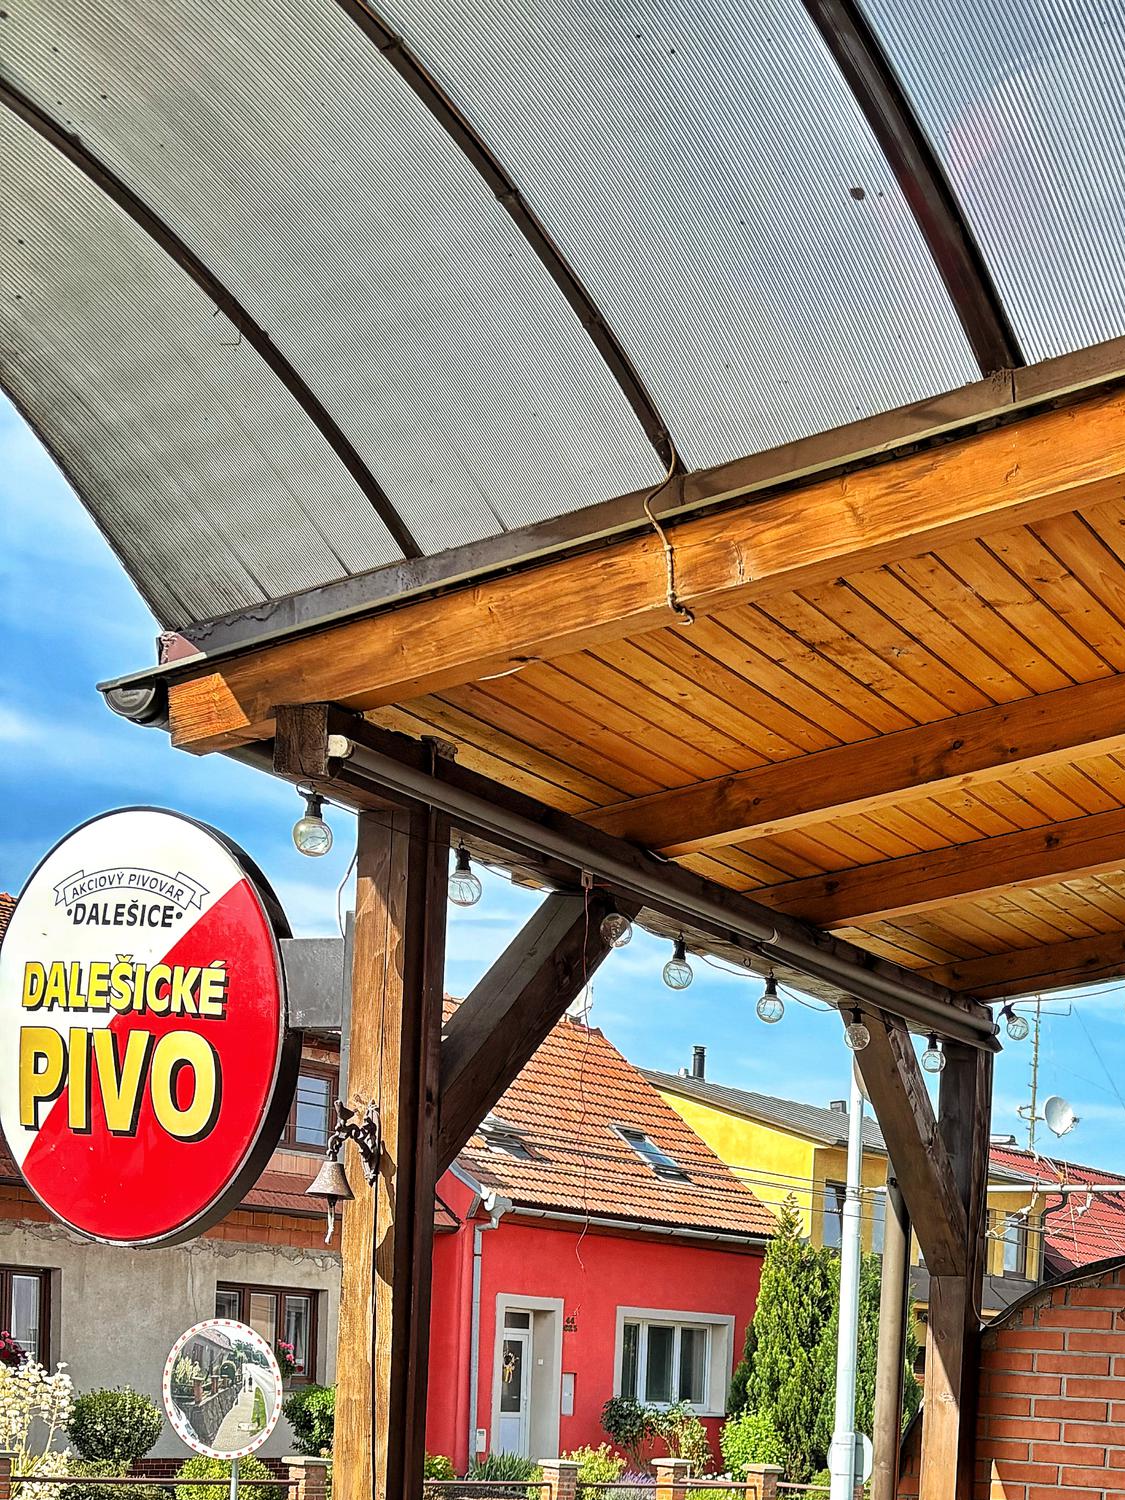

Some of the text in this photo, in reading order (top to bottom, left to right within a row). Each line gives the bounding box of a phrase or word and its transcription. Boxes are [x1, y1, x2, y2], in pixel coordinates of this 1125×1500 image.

[72, 872, 185, 901] AKCIOVÝ PIVOVAR
[22, 955, 228, 1019] DALEŠICKÉ
[19, 1027, 221, 1141] PIVO
